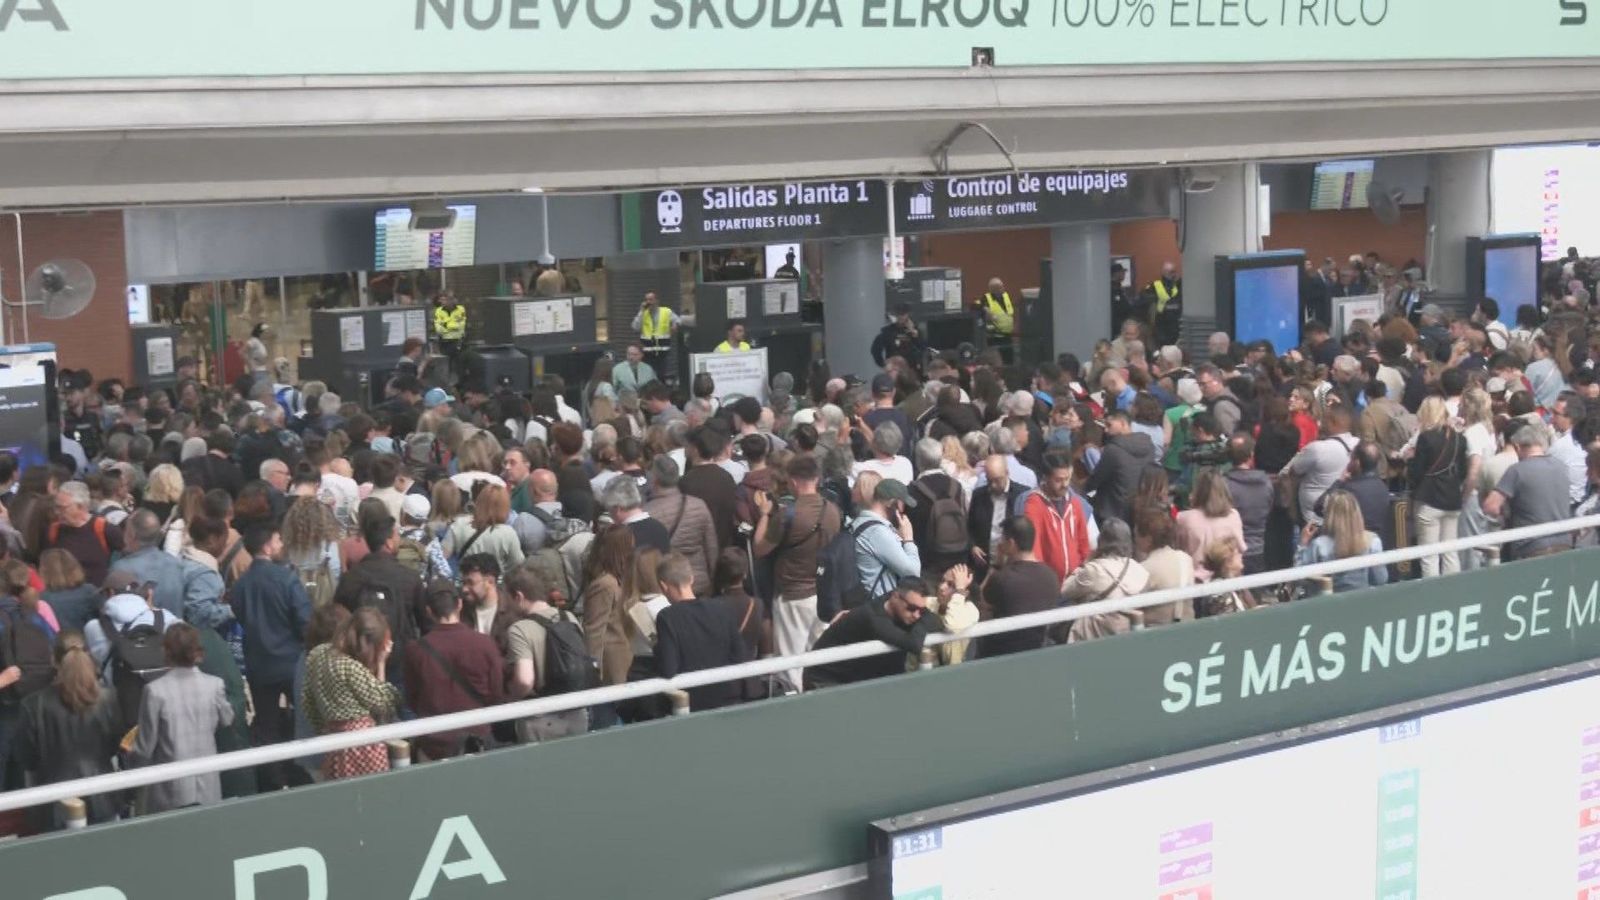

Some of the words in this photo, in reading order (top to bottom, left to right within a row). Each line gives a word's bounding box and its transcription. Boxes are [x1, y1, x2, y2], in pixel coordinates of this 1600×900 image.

[414, 0, 632, 31] NUEVO
[862, 0, 1028, 29] ELROQ
[1051, 0, 1155, 28] 100%
[703, 184, 778, 210] Salidas
[784, 182, 850, 206] Planta
[856, 181, 869, 203] 1
[947, 174, 1012, 198] Control
[1018, 173, 1041, 194] de
[1045, 169, 1129, 195] equipajes
[703, 216, 775, 232] DEPARTURES
[777, 214, 812, 229] FLOOR
[814, 213, 822, 226] 1
[948, 206, 993, 218] LUGGAGE
[996, 201, 1038, 215] CONTROL
[1161, 642, 1226, 714] SÉ
[1240, 624, 1347, 698] MÁS
[1360, 603, 1491, 673] NUBE.
[1503, 578, 1554, 642] SÉ
[893, 831, 938, 858] 11:31
